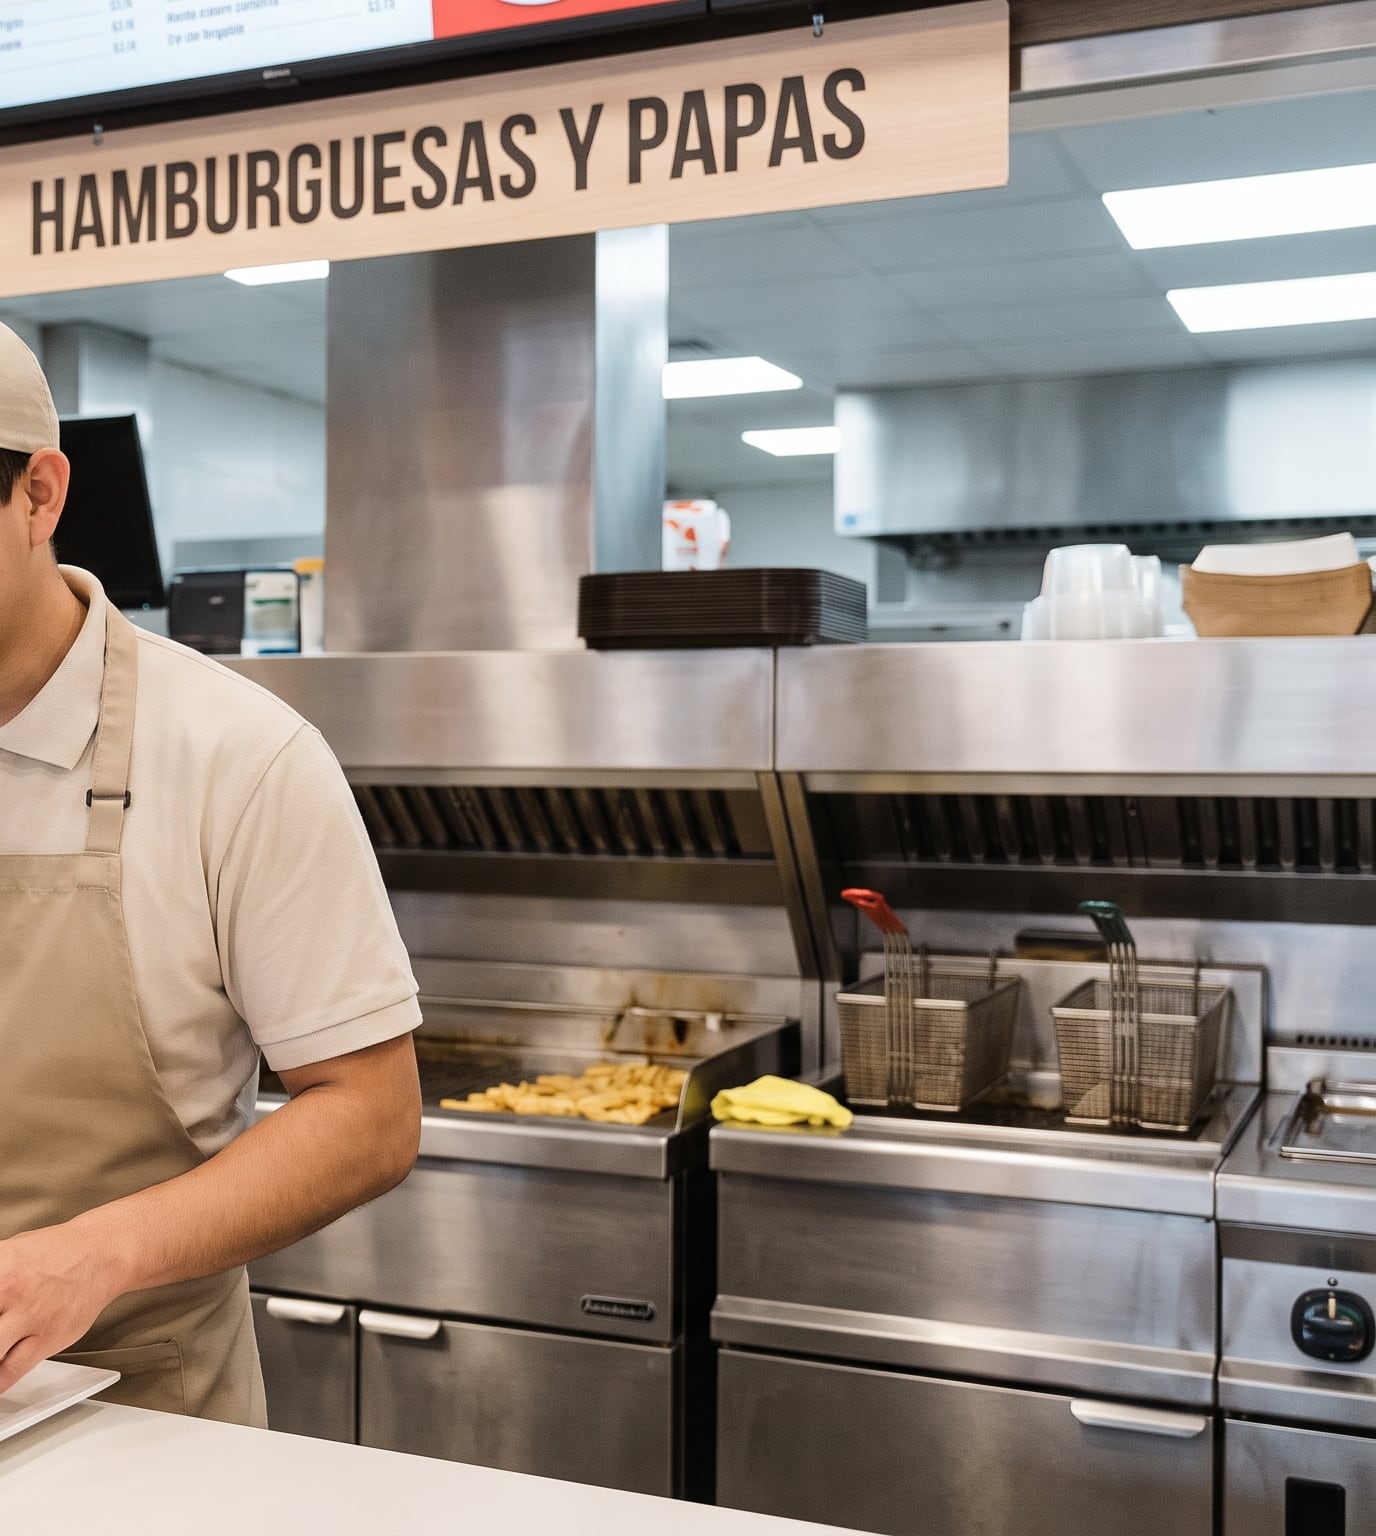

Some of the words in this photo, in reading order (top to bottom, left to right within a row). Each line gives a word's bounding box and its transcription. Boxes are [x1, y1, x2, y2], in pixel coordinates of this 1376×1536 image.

[31, 113, 537, 255] HAMBURGUESAS
[558, 103, 605, 191] Y
[628, 67, 866, 185] PAPAS
